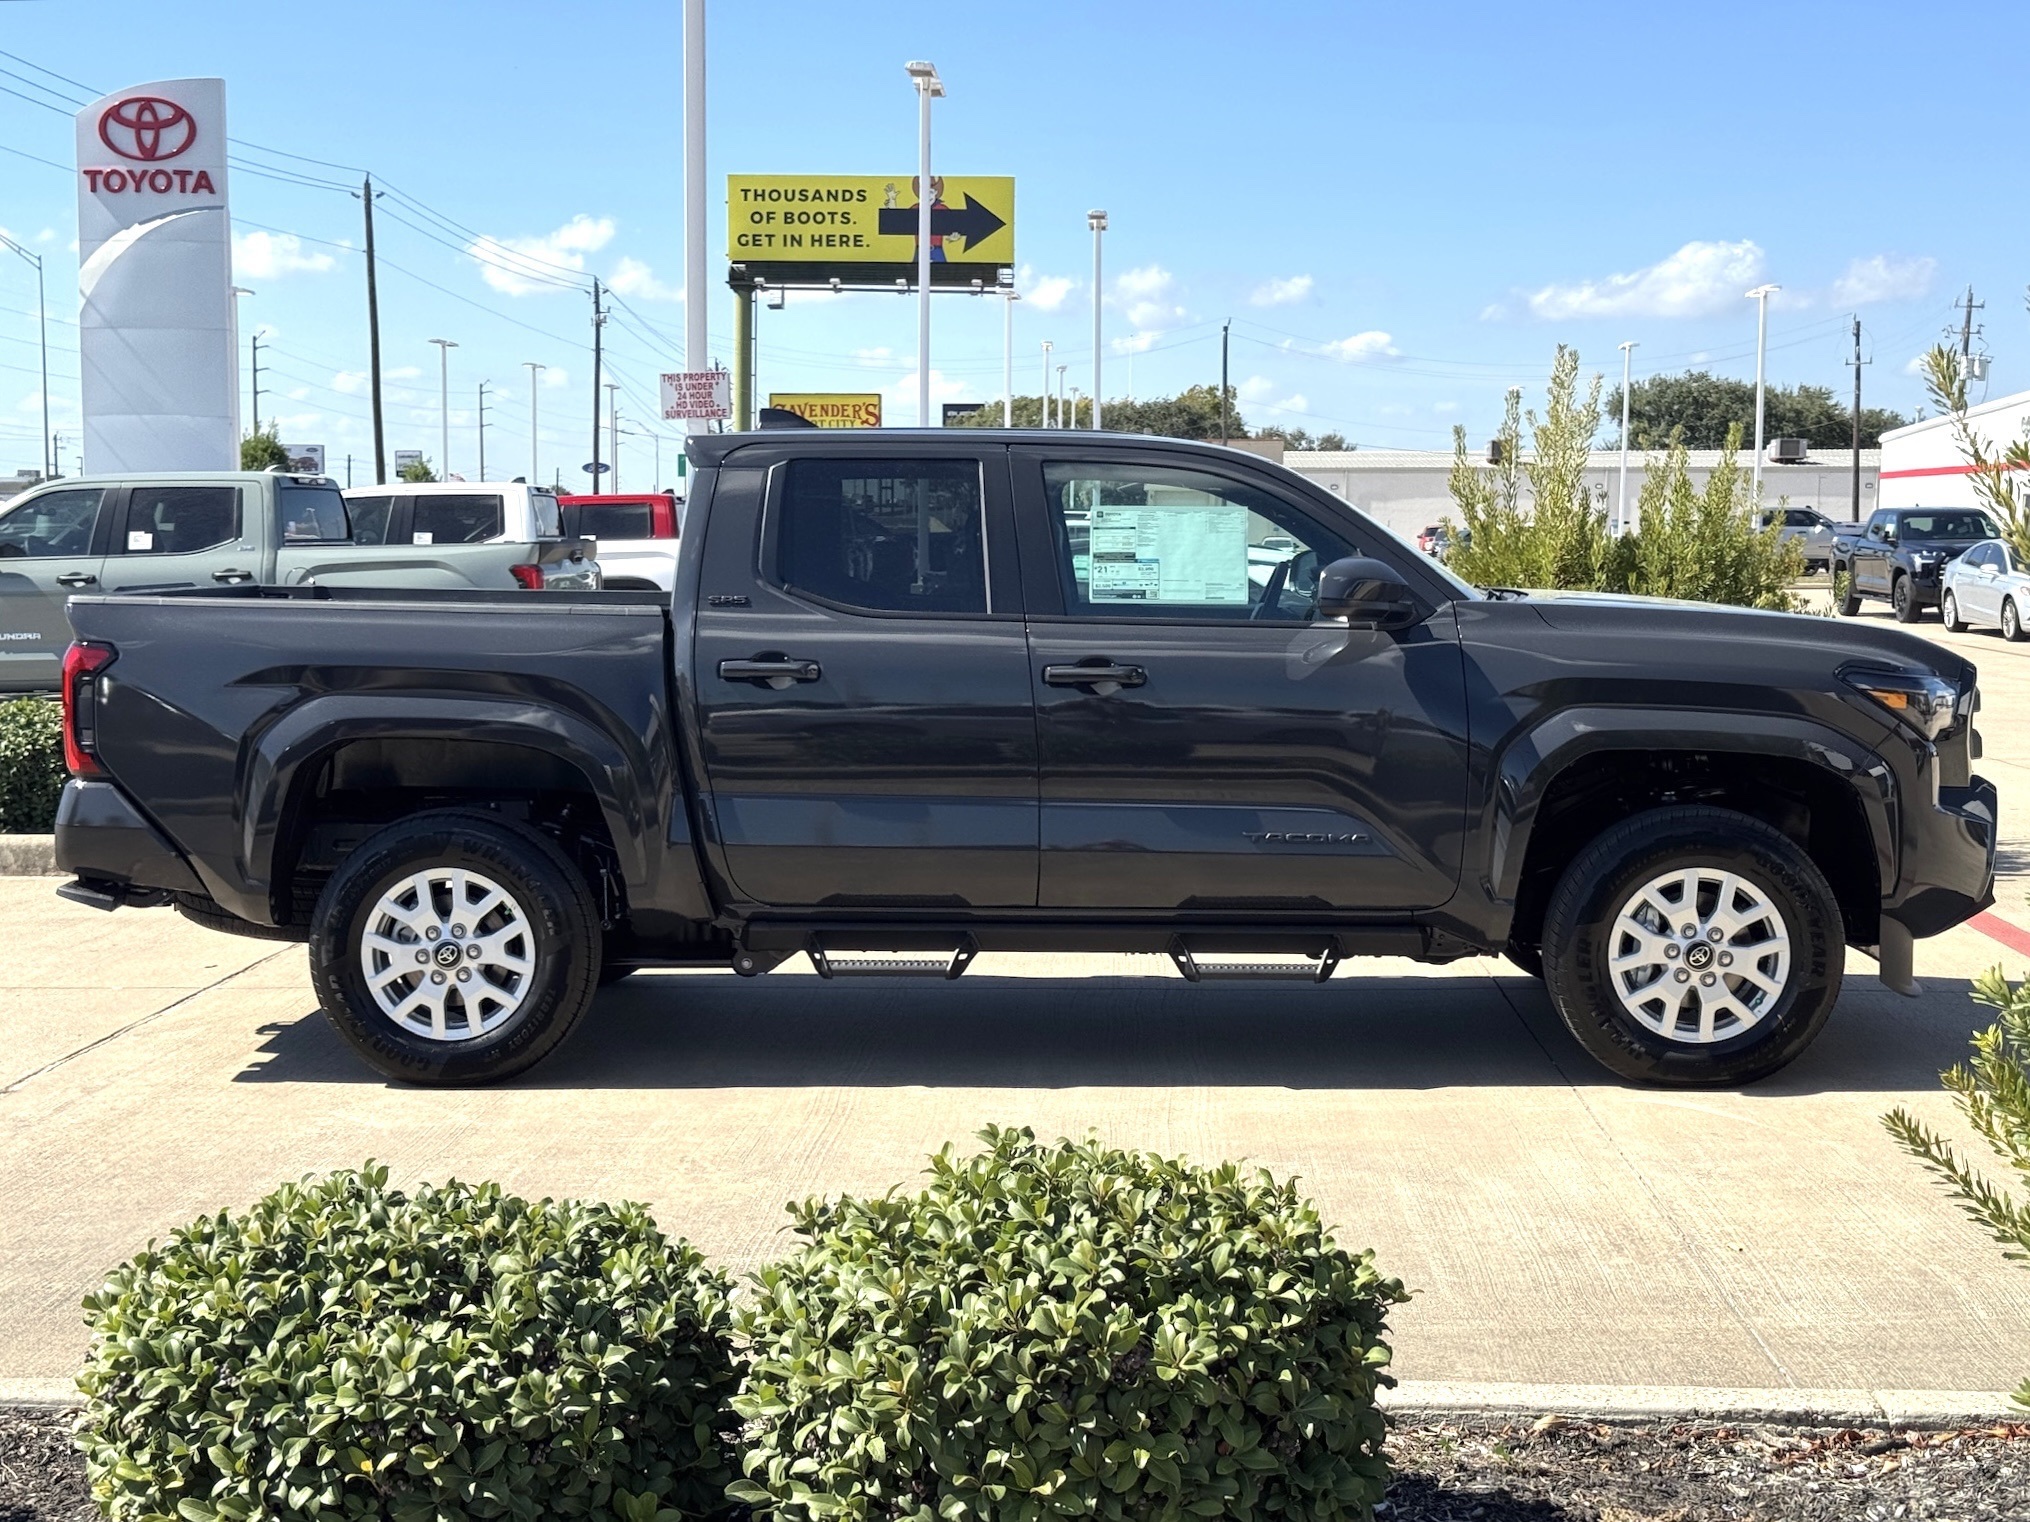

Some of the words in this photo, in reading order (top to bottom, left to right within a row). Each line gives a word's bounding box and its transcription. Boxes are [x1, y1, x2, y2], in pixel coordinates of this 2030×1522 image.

[83, 169, 216, 194] TOYOTA
[740, 188, 868, 202] THOUSANDS
[750, 211, 776, 225] OF
[783, 211, 857, 225] BOOTS.
[737, 233, 776, 247] GET
[783, 234, 802, 247] IN
[810, 234, 871, 248] HERE.
[661, 373, 681, 383] THIS
[682, 372, 727, 382] PROPERTY
[675, 383, 683, 392] IS
[685, 382, 714, 391] UNDER
[677, 392, 687, 400] 24
[689, 391, 713, 400] HOUR
[676, 401, 688, 409] HD
[689, 400, 715, 409] VIDEO
[665, 409, 728, 419] SURVEILLANCE
[1242, 832, 1369, 843] TACOMA
